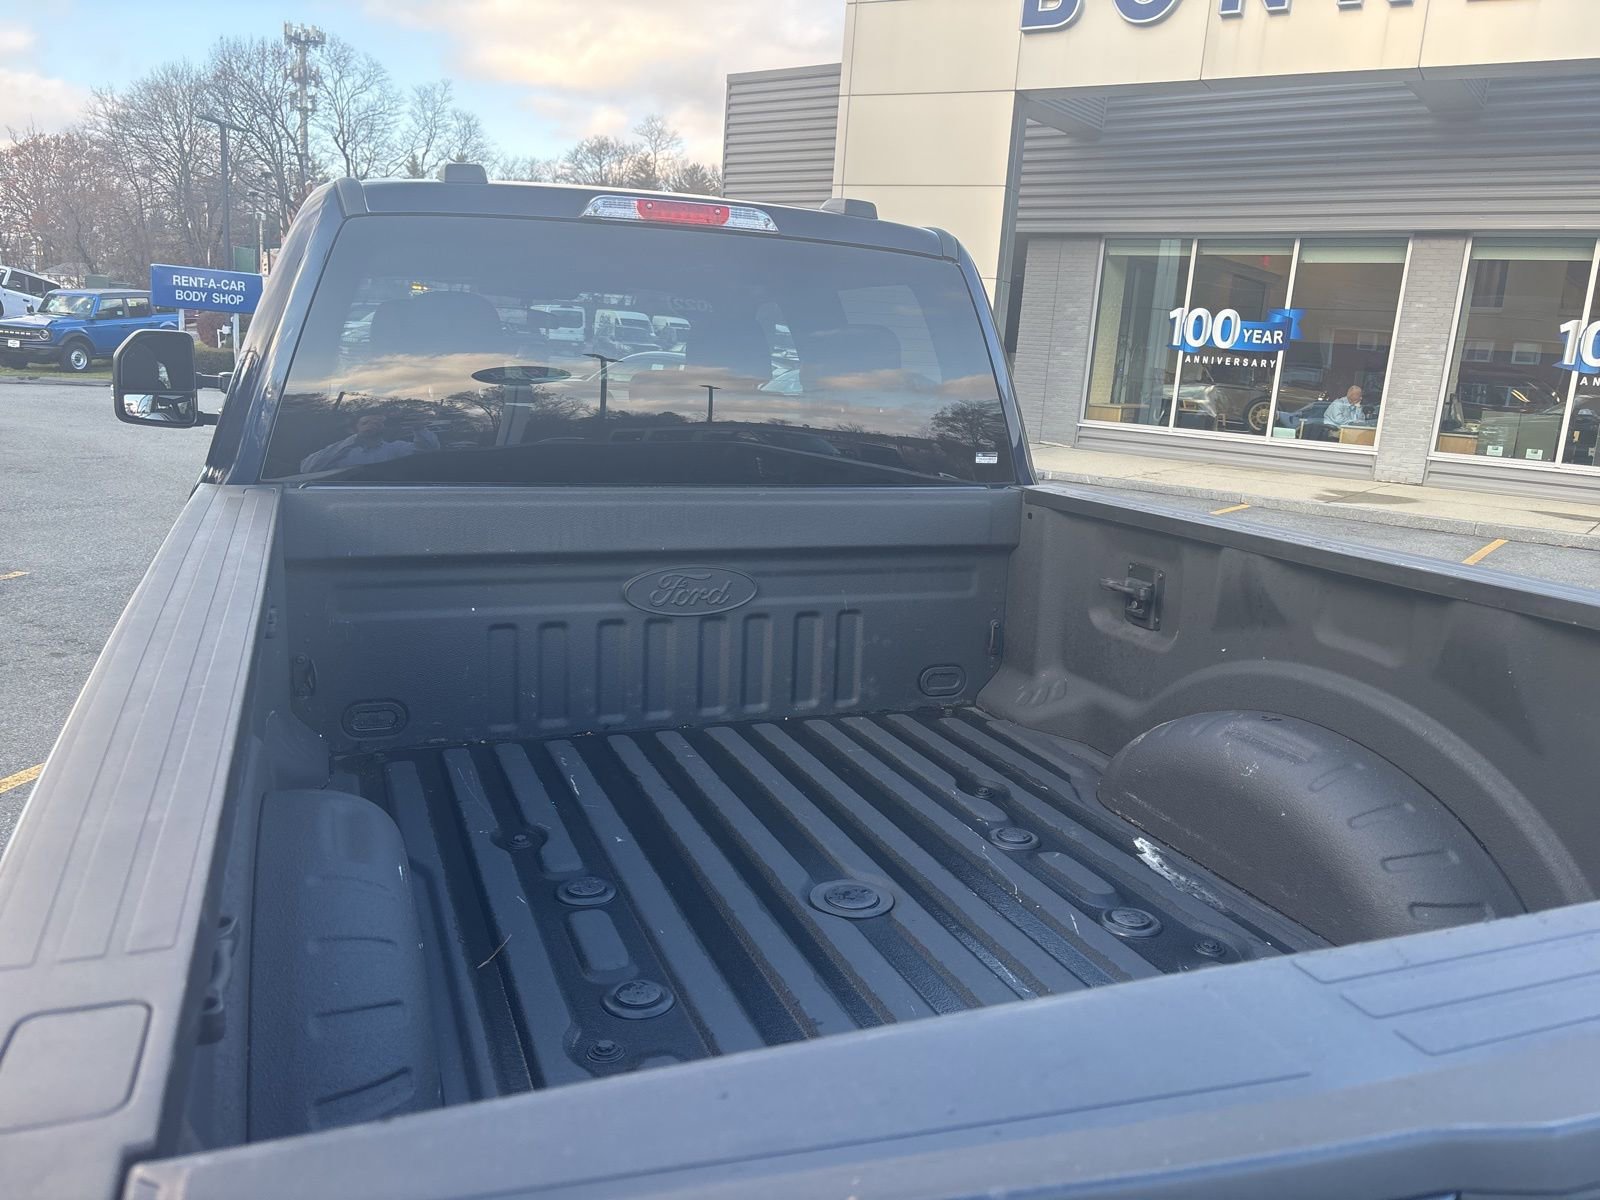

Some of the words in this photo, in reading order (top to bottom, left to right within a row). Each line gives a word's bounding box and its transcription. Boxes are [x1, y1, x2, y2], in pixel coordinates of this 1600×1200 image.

[172, 274, 246, 292] RENT-A-CAR
[175, 289, 207, 302] BODY
[212, 292, 244, 305] SHOP
[1169, 307, 1241, 349] 100
[1242, 328, 1283, 344] YEAR
[1184, 354, 1277, 369] ANNIVERSARY
[650, 573, 733, 607] Ford
